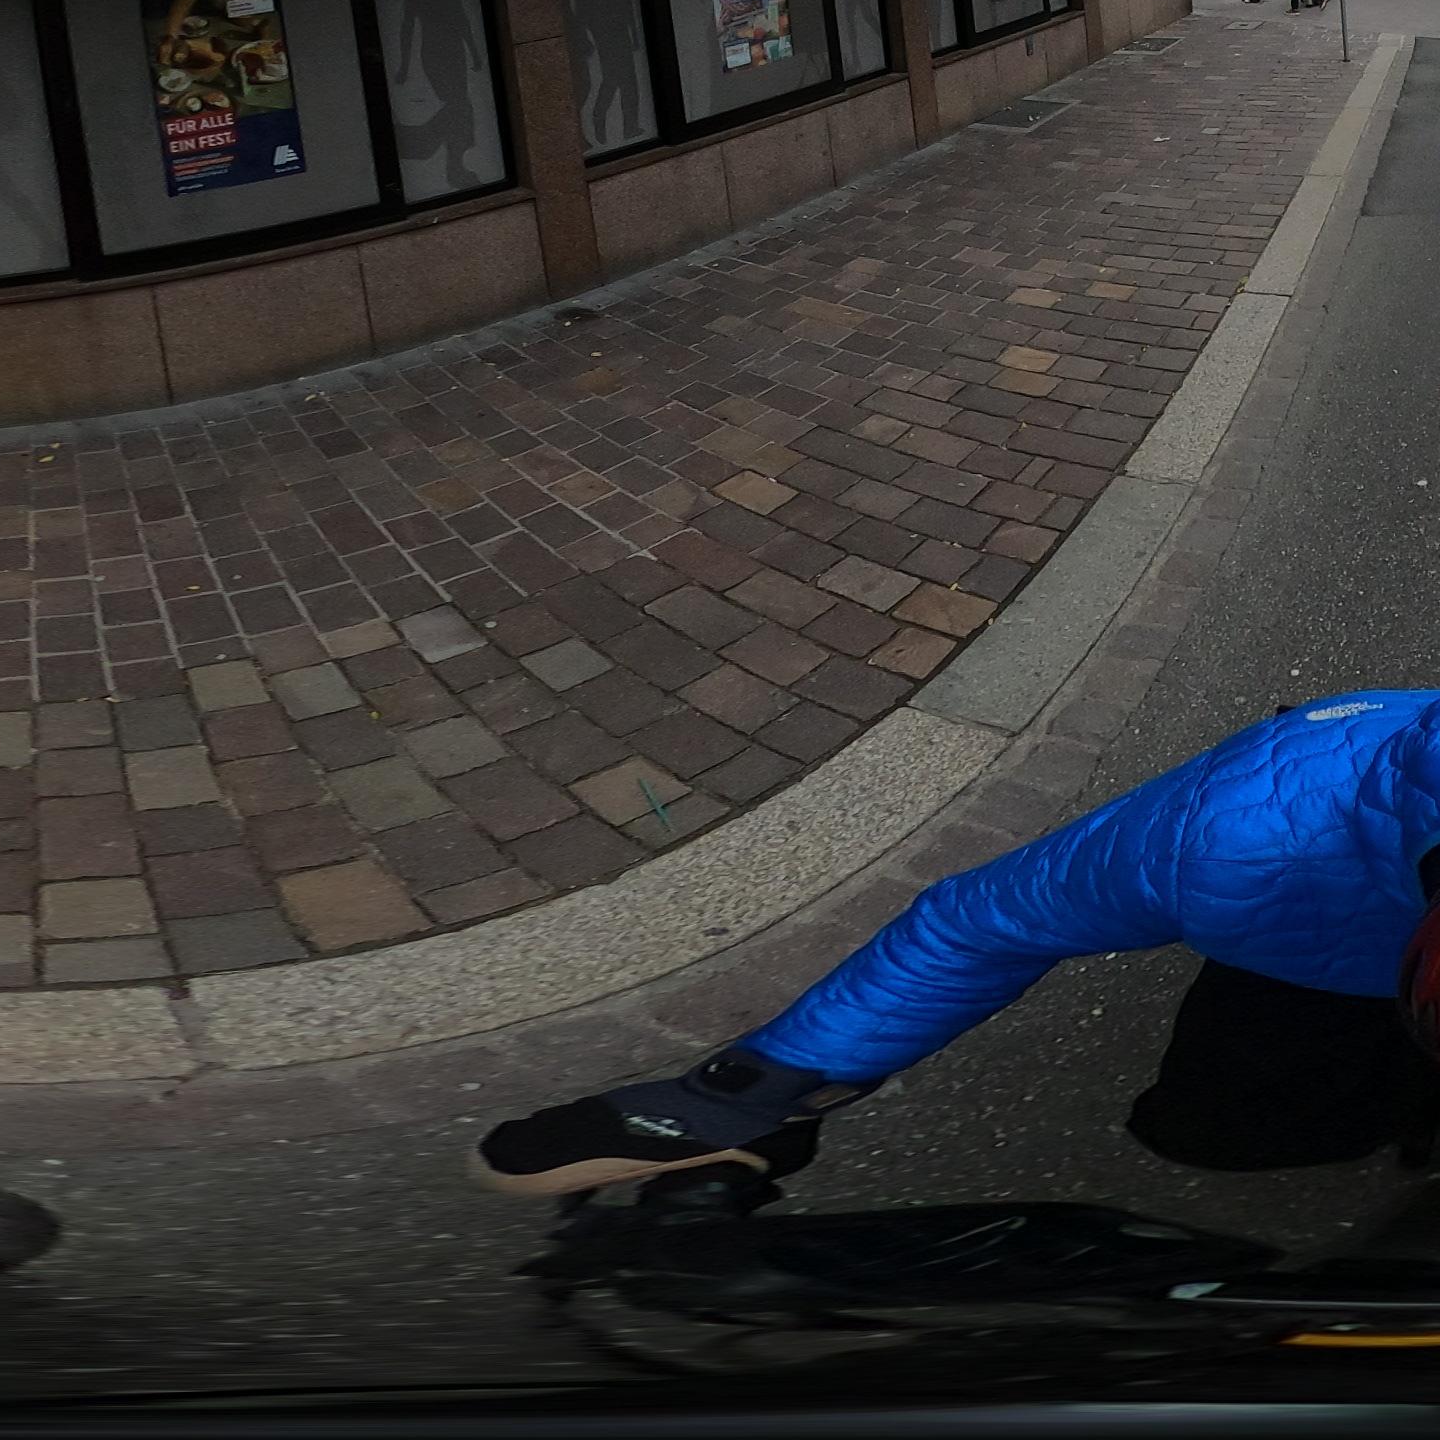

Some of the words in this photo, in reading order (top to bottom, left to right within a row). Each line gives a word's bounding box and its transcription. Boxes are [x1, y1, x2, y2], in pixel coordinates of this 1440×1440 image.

[166, 118, 197, 135] FÜR
[200, 113, 235, 130] ALLE
[169, 138, 197, 153] EIN
[198, 132, 236, 148] FEST.
